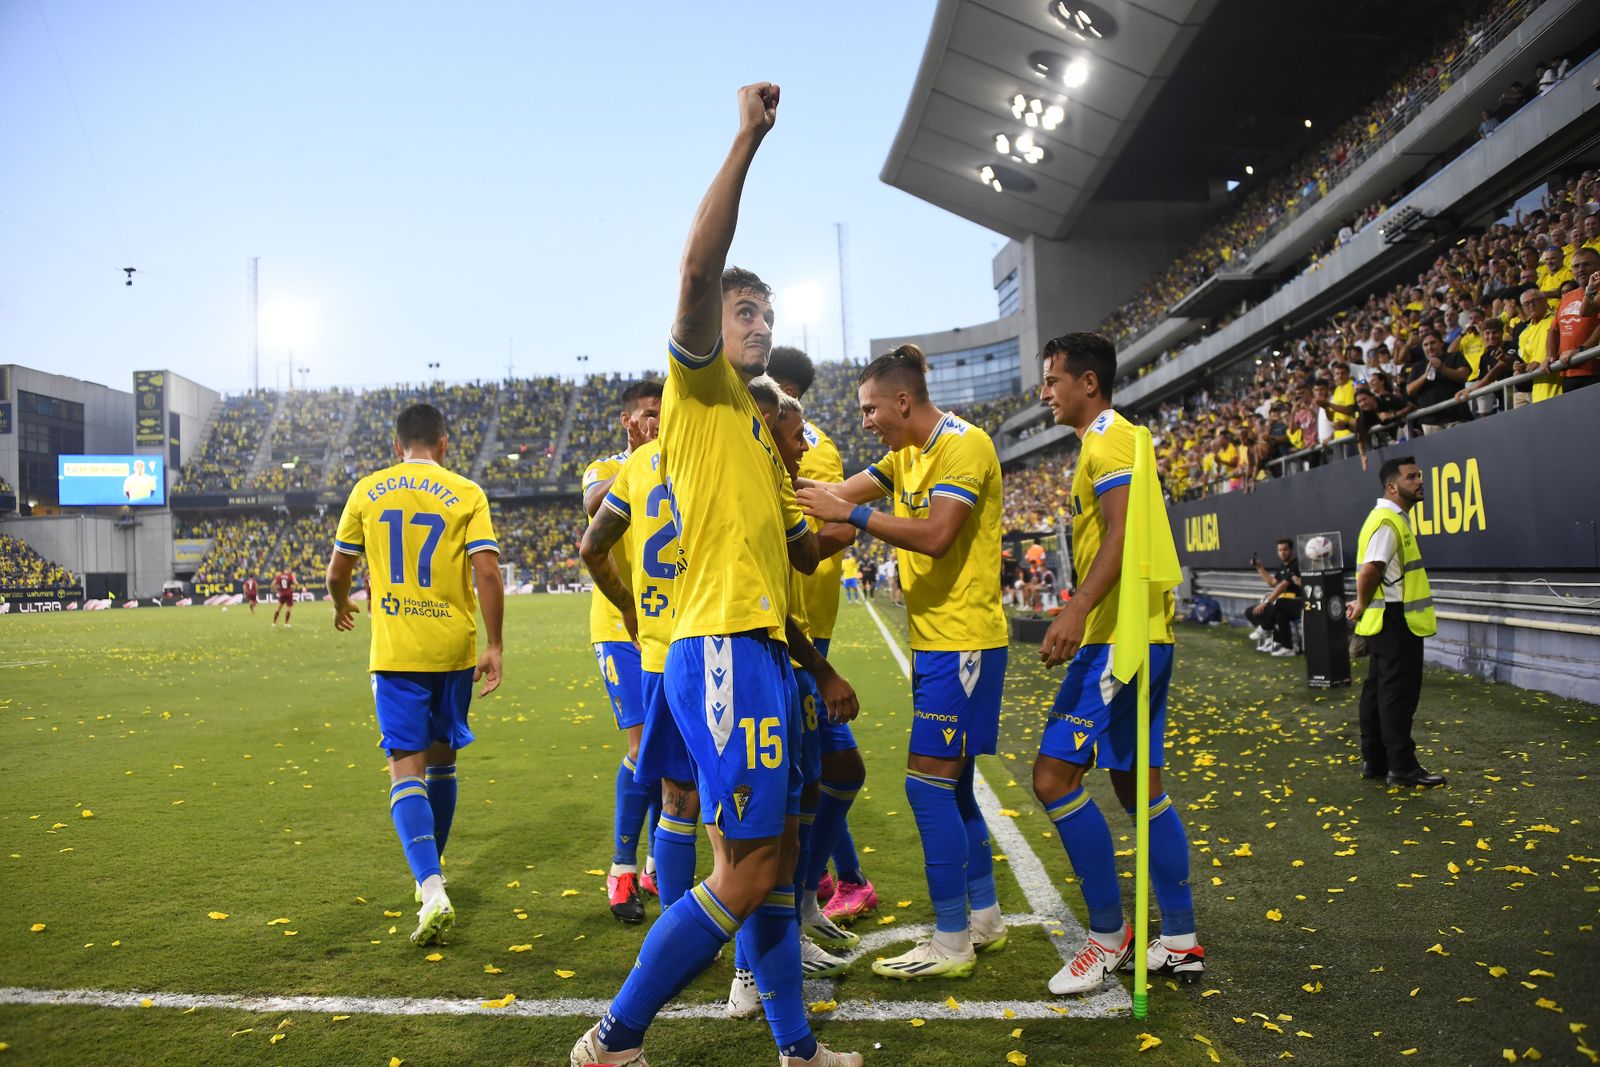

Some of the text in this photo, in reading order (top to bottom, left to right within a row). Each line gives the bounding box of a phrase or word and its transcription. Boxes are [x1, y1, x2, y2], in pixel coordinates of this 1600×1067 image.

[367, 476, 460, 508] ESCALANTE
[1409, 457, 1487, 536] LIGA
[1185, 512, 1220, 553] LALIGA
[378, 509, 446, 588] 17
[195, 583, 234, 594] DIGI
[256, 591, 315, 604] ULRA
[547, 583, 594, 593] ULTR
[19, 601, 62, 613] ULTRA
[404, 597, 450, 609] Hospitales
[404, 607, 453, 618] PASCUAL
[605, 654, 620, 687] 4
[801, 695, 818, 734] 8
[914, 710, 958, 723] humans
[738, 716, 783, 770] 15
